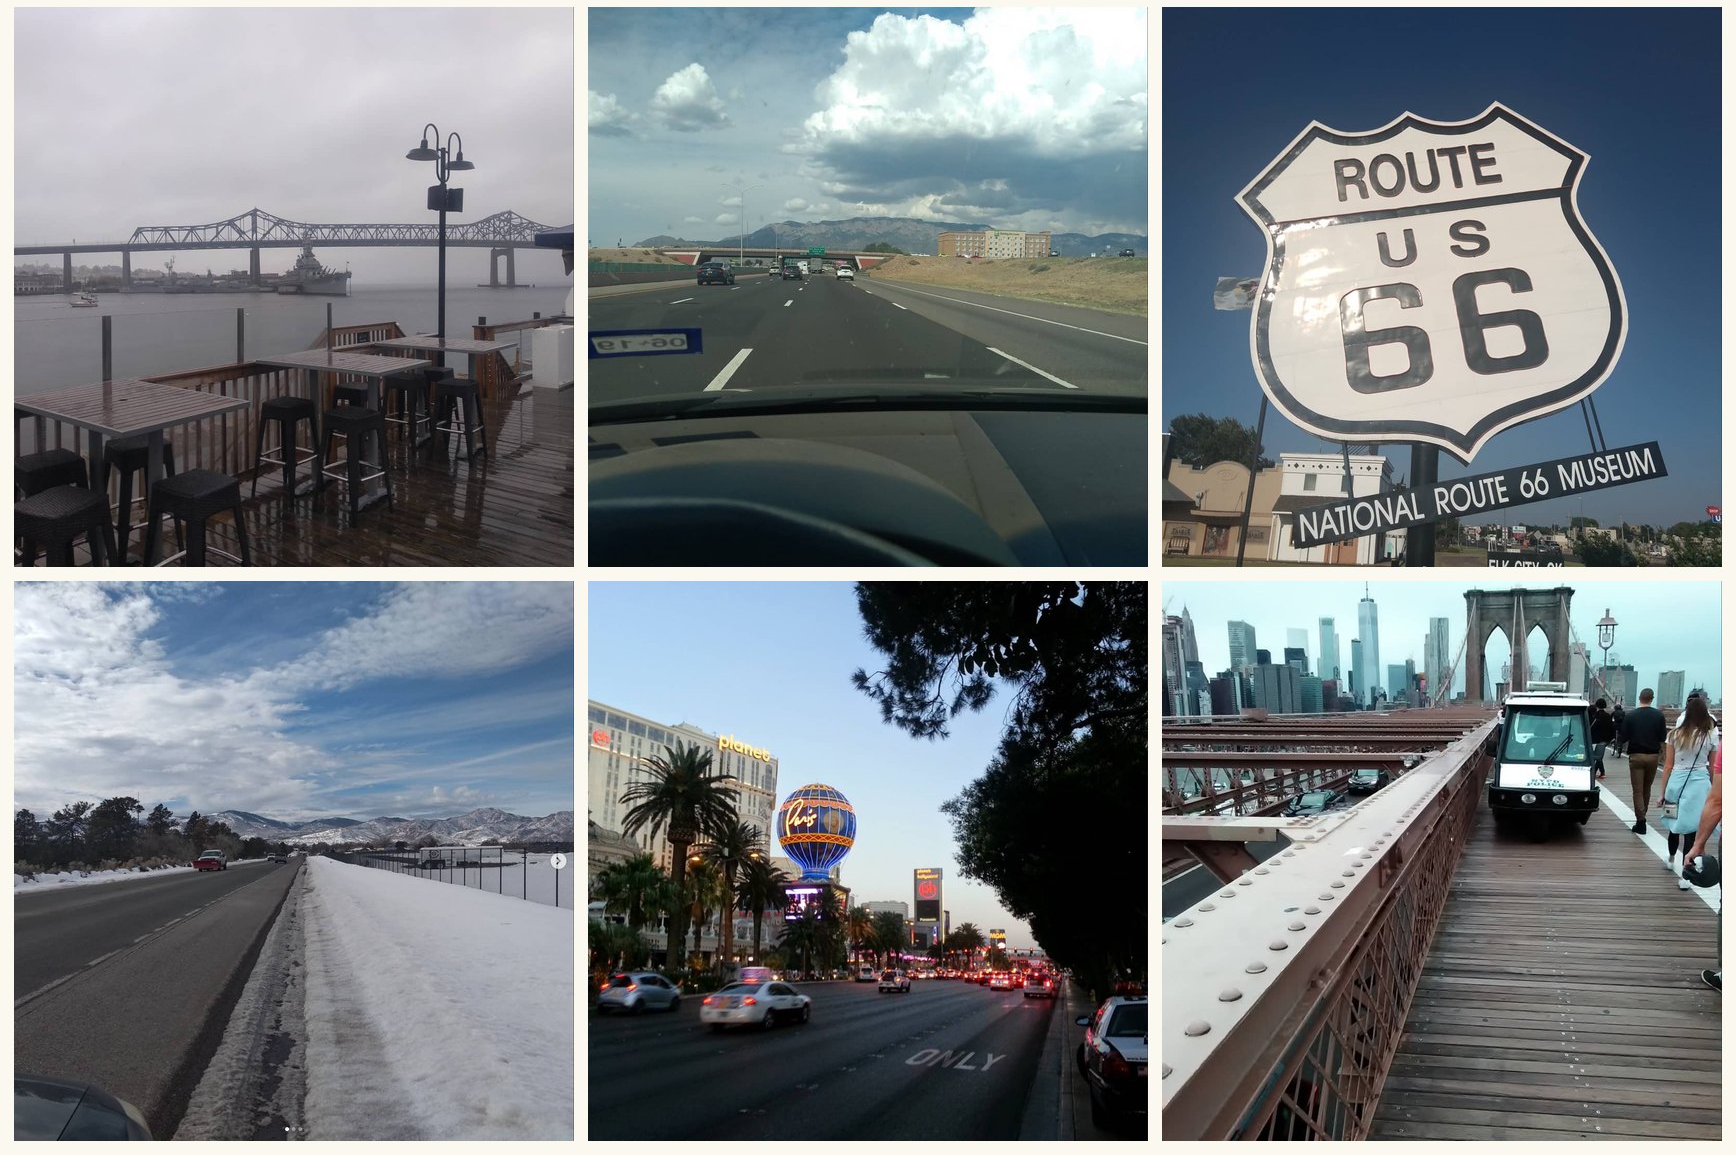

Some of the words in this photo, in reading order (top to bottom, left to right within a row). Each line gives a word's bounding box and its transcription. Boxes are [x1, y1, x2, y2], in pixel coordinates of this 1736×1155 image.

[1333, 142, 1503, 202] ROUTE
[1339, 267, 1550, 395] 66
[1299, 492, 1425, 542] NATIONAL
[1433, 475, 1510, 516] ROUTE
[1519, 468, 1550, 499] 66
[1557, 447, 1657, 492] MUSEUM
[718, 733, 771, 762] planet
[785, 798, 818, 838] Paris
[904, 1048, 1007, 1072] ONLY
